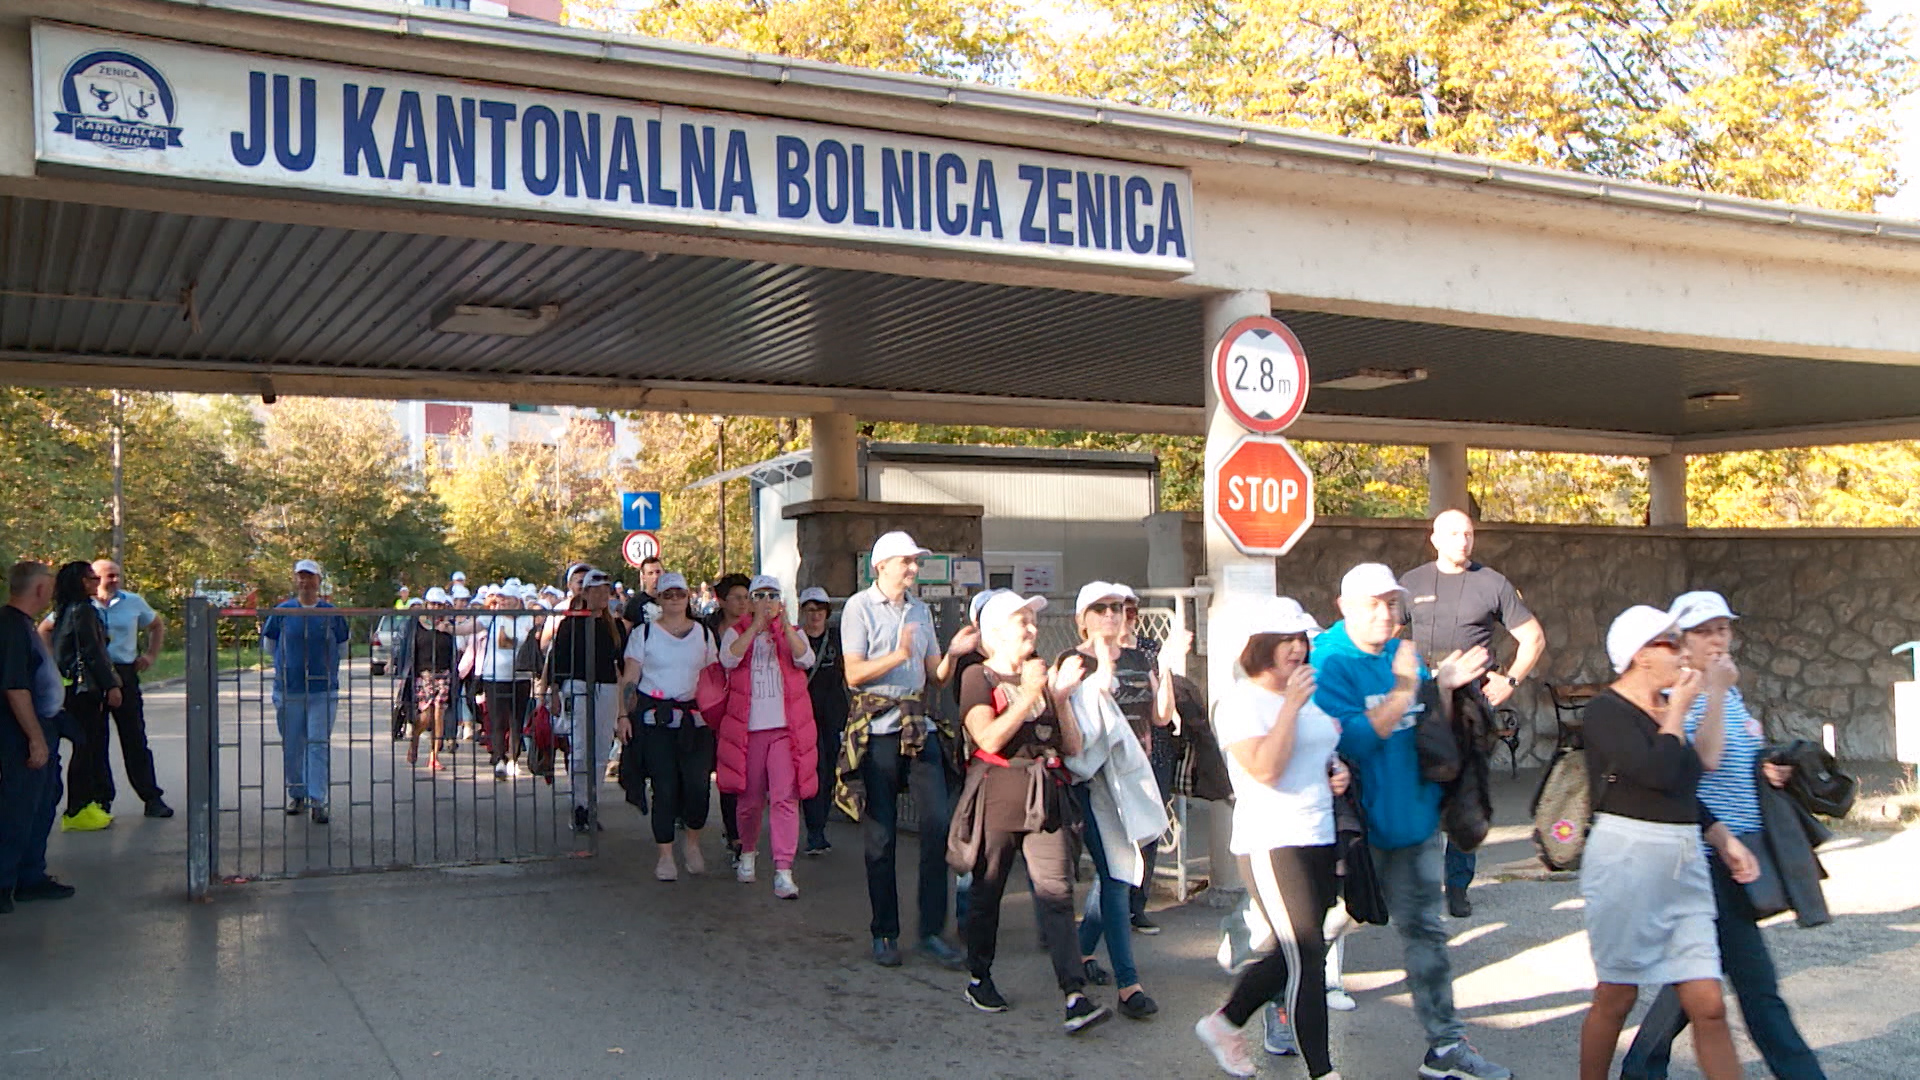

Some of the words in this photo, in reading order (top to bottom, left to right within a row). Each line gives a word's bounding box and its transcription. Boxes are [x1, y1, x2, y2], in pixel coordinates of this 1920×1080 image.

[99, 66, 139, 78] ZENICA
[76, 121, 166, 139] KANTONALNA
[92, 133, 151, 147] BOLNICA
[230, 71, 317, 172] JU
[342, 83, 757, 214] KANTONALNA
[776, 135, 1004, 240] BOLNICA
[1018, 164, 1187, 258] ZENICA
[1228, 475, 1299, 514] STOP
[632, 540, 653, 559] 30
